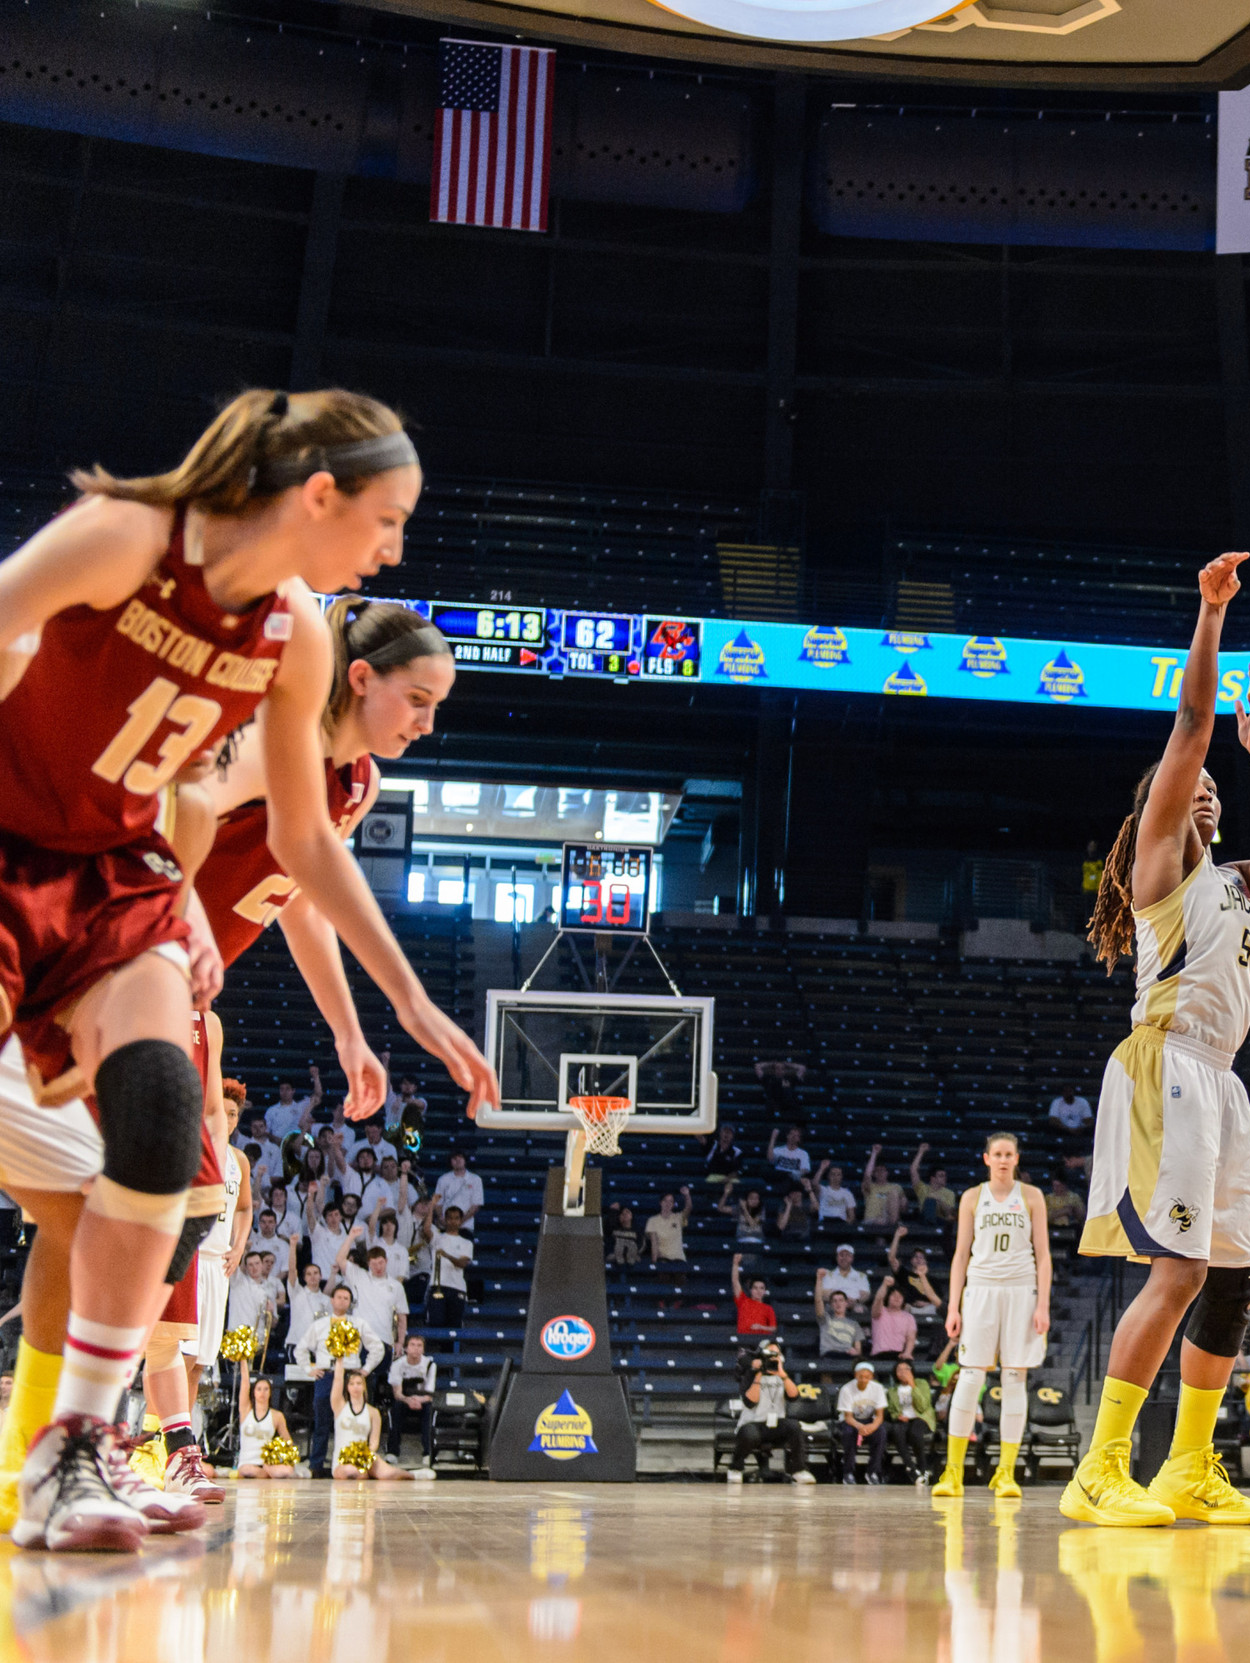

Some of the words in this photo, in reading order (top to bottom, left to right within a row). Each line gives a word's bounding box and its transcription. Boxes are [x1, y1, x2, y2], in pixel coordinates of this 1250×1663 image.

[490, 590, 512, 601] 214
[476, 610, 541, 641] 6:13
[575, 618, 615, 650] 62
[116, 598, 215, 677] BOSTON
[455, 645, 481, 661] 2ND
[482, 647, 512, 662] HALF
[569, 652, 595, 671] TOL
[608, 654, 619, 672] 3
[91, 677, 222, 795] 13
[580, 880, 630, 924] 30
[980, 1213, 1025, 1230] JACKETS
[994, 1234, 1010, 1252] 10
[547, 1321, 590, 1354] Kroger
[540, 1418, 587, 1434] Superior
[540, 1433, 587, 1449] PLUMBING
